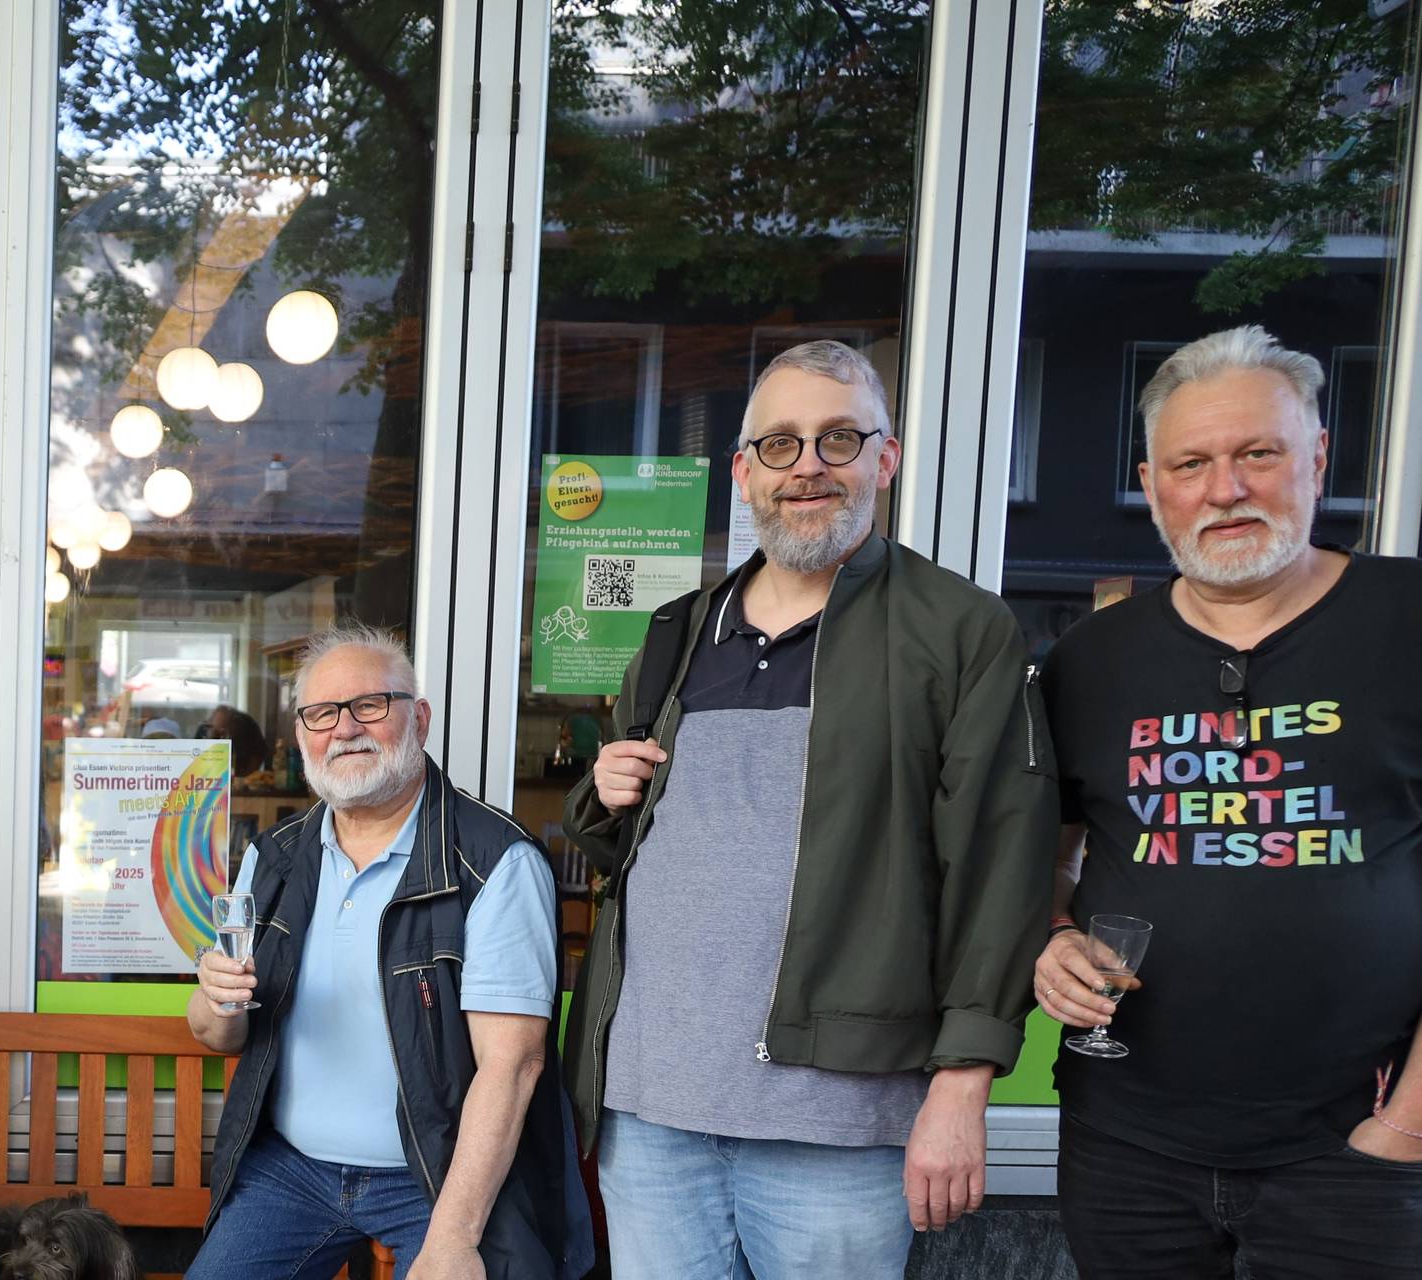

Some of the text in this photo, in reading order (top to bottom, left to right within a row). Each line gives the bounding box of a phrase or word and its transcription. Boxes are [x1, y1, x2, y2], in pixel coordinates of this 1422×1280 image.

[559, 472, 589, 484] Profi-
[558, 485, 592, 496] Eltern
[554, 494, 599, 510] gesucht!
[546, 525, 643, 538] Erziehungsstelle
[647, 528, 691, 537] werden
[546, 537, 680, 550] Pflegekind aufnehmen
[1129, 700, 1343, 749] BUNTES
[1128, 750, 1306, 788] NORD-
[74, 773, 223, 791] Summertime Jazz
[118, 793, 170, 813] meets
[175, 790, 199, 807] Art
[1127, 785, 1346, 825] VIERTEL
[1132, 828, 1365, 867] IN ESSEN
[114, 867, 145, 879] 2025
[112, 882, 125, 890] Uhr
